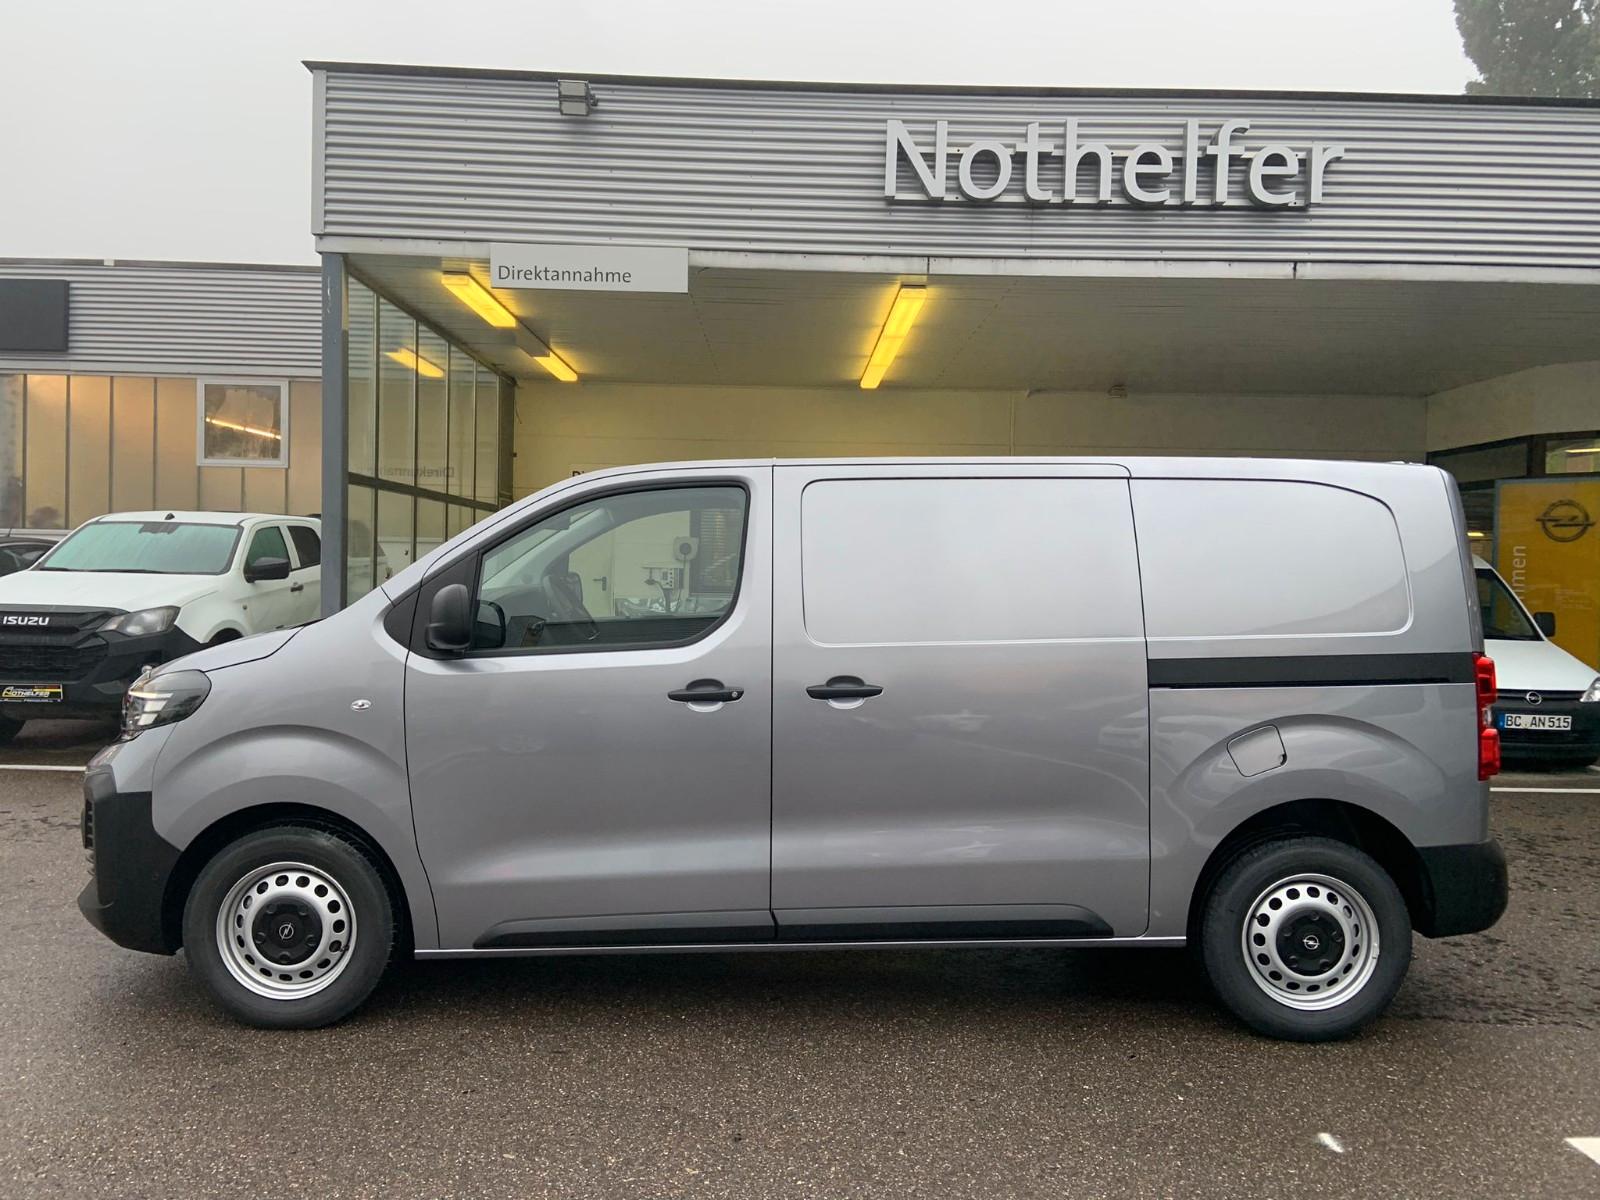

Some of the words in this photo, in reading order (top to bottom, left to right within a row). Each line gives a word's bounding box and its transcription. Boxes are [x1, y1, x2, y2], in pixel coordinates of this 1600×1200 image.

[884, 118, 1345, 207] Nothelfer
[498, 265, 632, 283] Direktannahme
[3, 616, 49, 625] ISUZU
[1506, 715, 1522, 727] BC
[1548, 717, 1570, 728] 515
